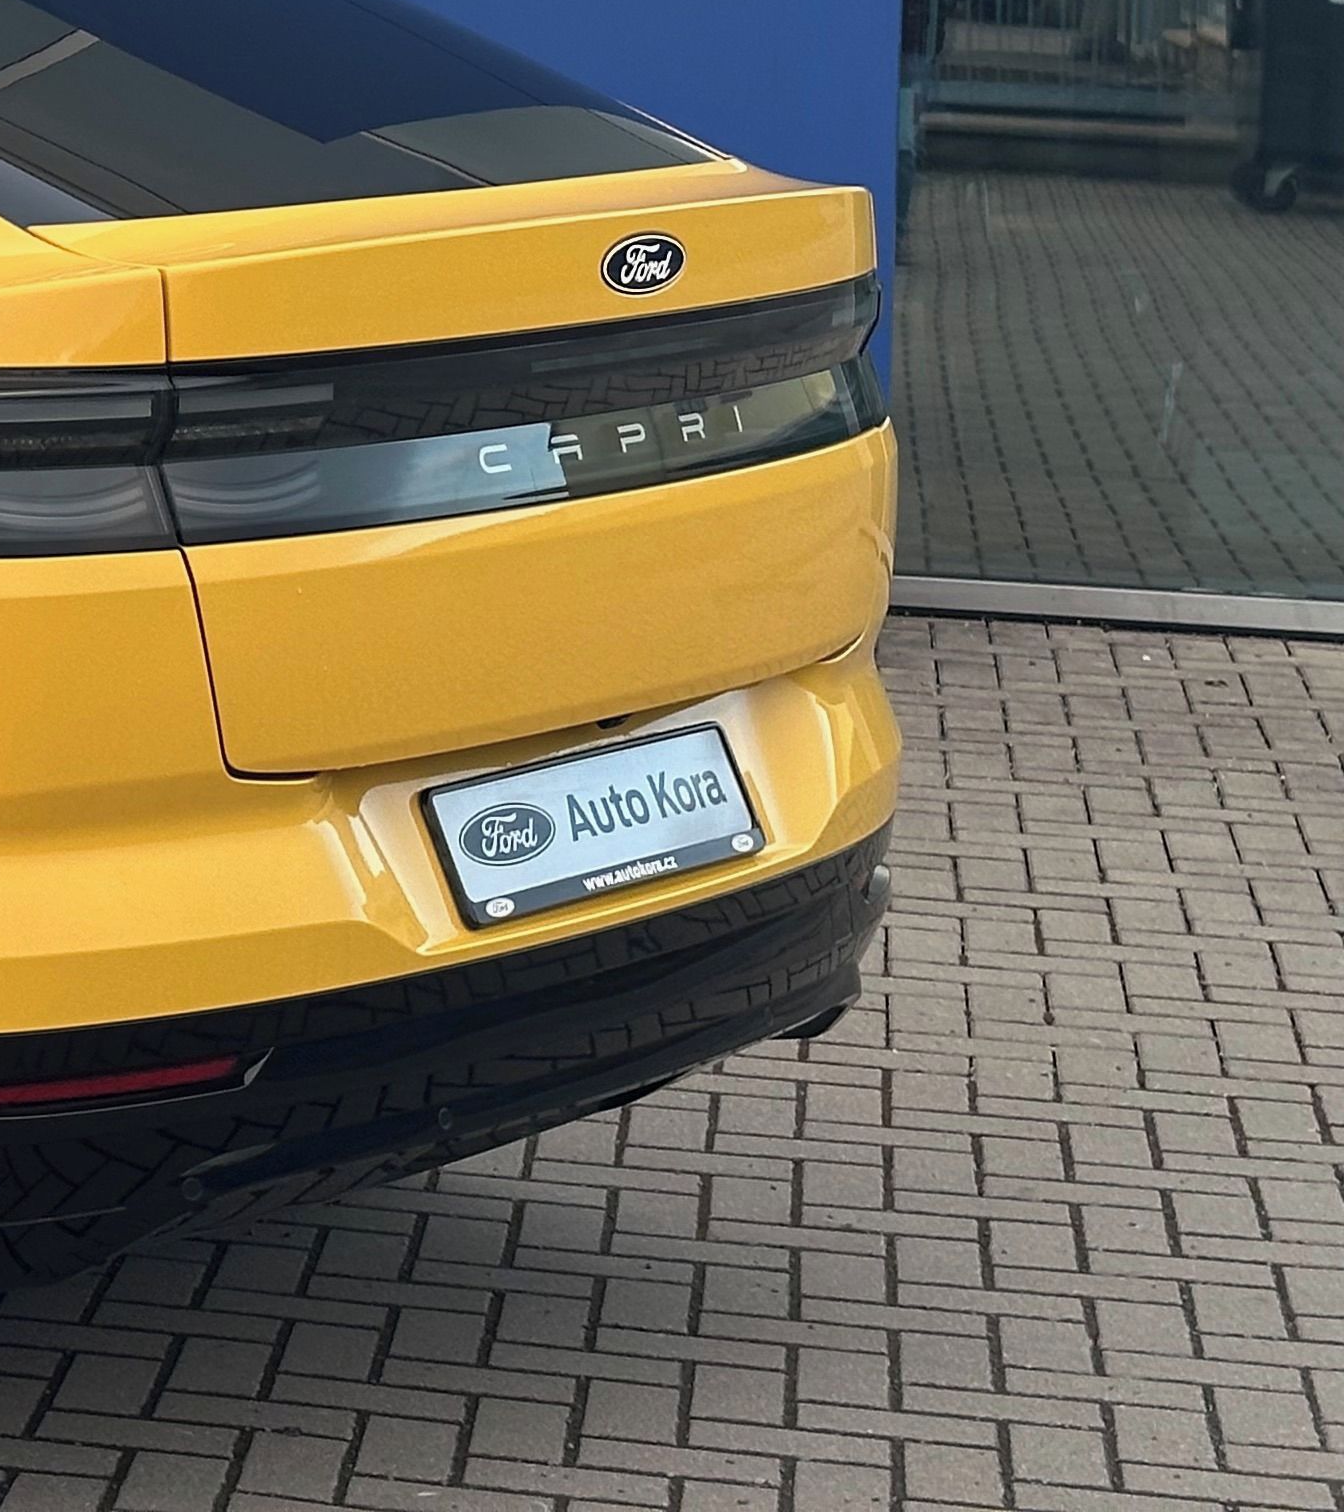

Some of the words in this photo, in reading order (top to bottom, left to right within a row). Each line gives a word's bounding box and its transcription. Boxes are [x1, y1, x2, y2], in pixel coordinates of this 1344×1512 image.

[620, 244, 672, 283] Ford
[479, 405, 743, 474] CAPRI
[481, 812, 538, 858] Ford
[566, 785, 650, 842] Auto
[646, 769, 727, 819] Kora
[582, 856, 679, 892] www.autokora.cz
